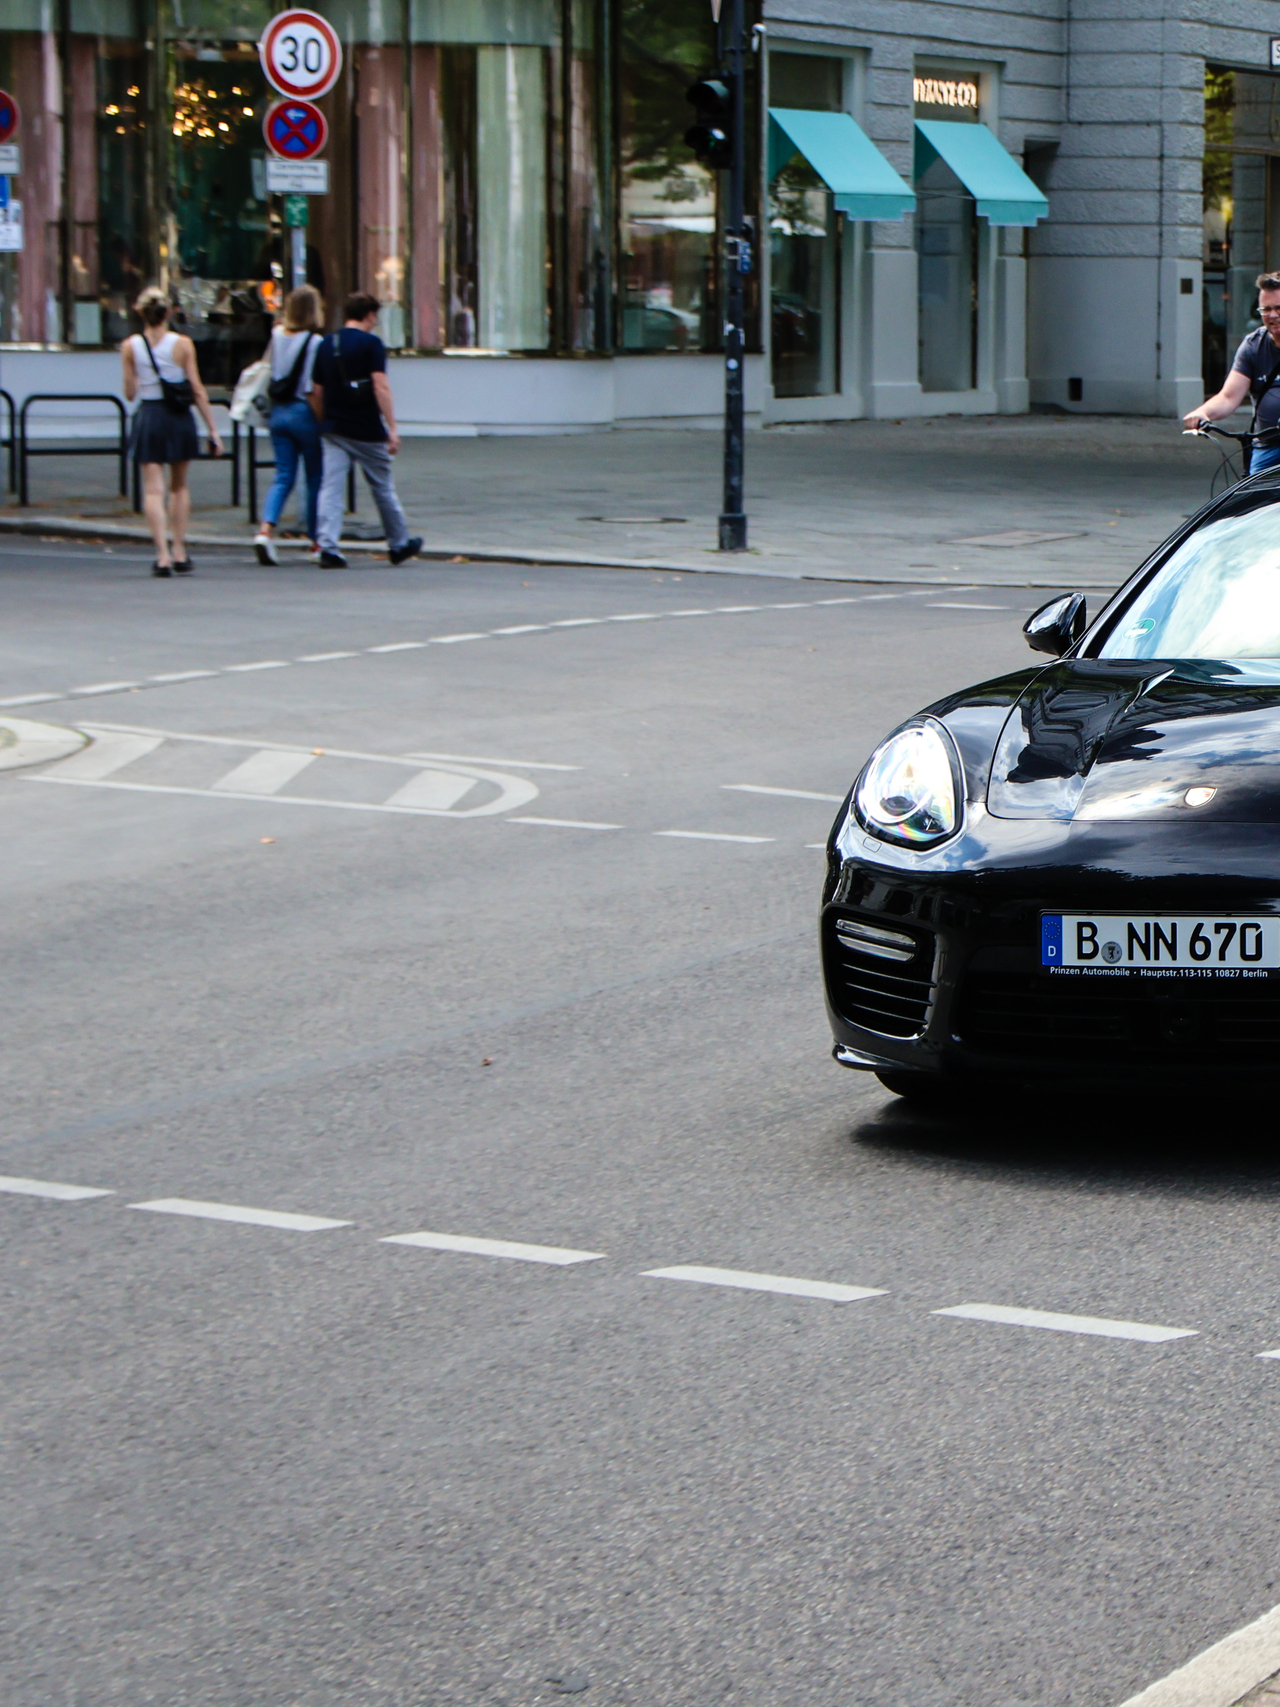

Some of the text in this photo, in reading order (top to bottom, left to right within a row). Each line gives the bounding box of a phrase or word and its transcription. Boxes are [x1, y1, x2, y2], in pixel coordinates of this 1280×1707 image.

[280, 36, 321, 73] 30
[1047, 945, 1057, 957] D
[1076, 921, 1263, 962] B NN 670
[1050, 966, 1080, 975] Prinzen
[1082, 967, 1130, 976] Automobile
[1214, 969, 1240, 978] 10827
[1242, 969, 1268, 978] Berlin
